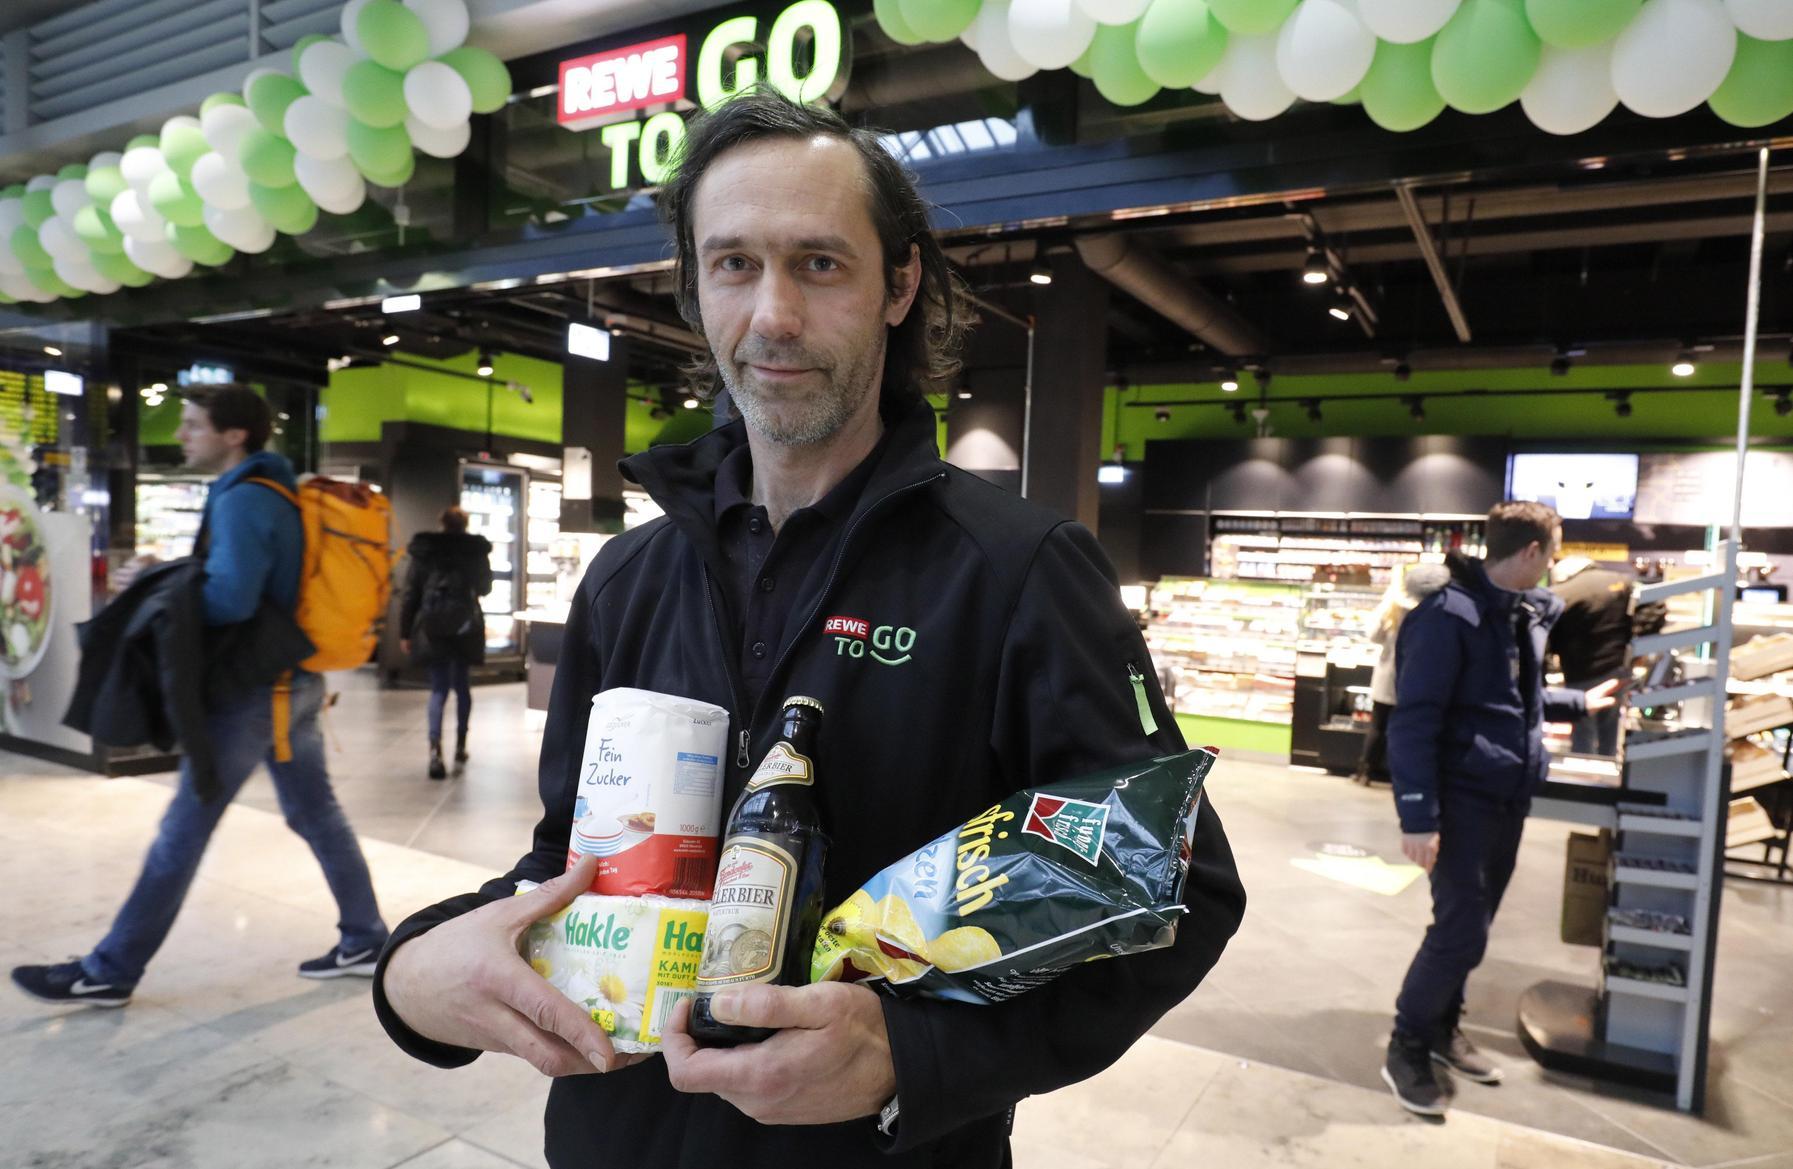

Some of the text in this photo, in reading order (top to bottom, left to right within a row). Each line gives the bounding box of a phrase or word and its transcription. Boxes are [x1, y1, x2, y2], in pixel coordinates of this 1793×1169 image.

[697, 0, 841, 112] GO
[564, 45, 679, 115] REWE
[601, 111, 687, 190] TO
[825, 619, 867, 636] REWE
[872, 625, 917, 652] GO
[834, 636, 865, 658] TO
[598, 738, 622, 762] Fein
[586, 763, 631, 786] Zucker
[565, 911, 630, 951] Hakle
[658, 960, 697, 973] KAMI
